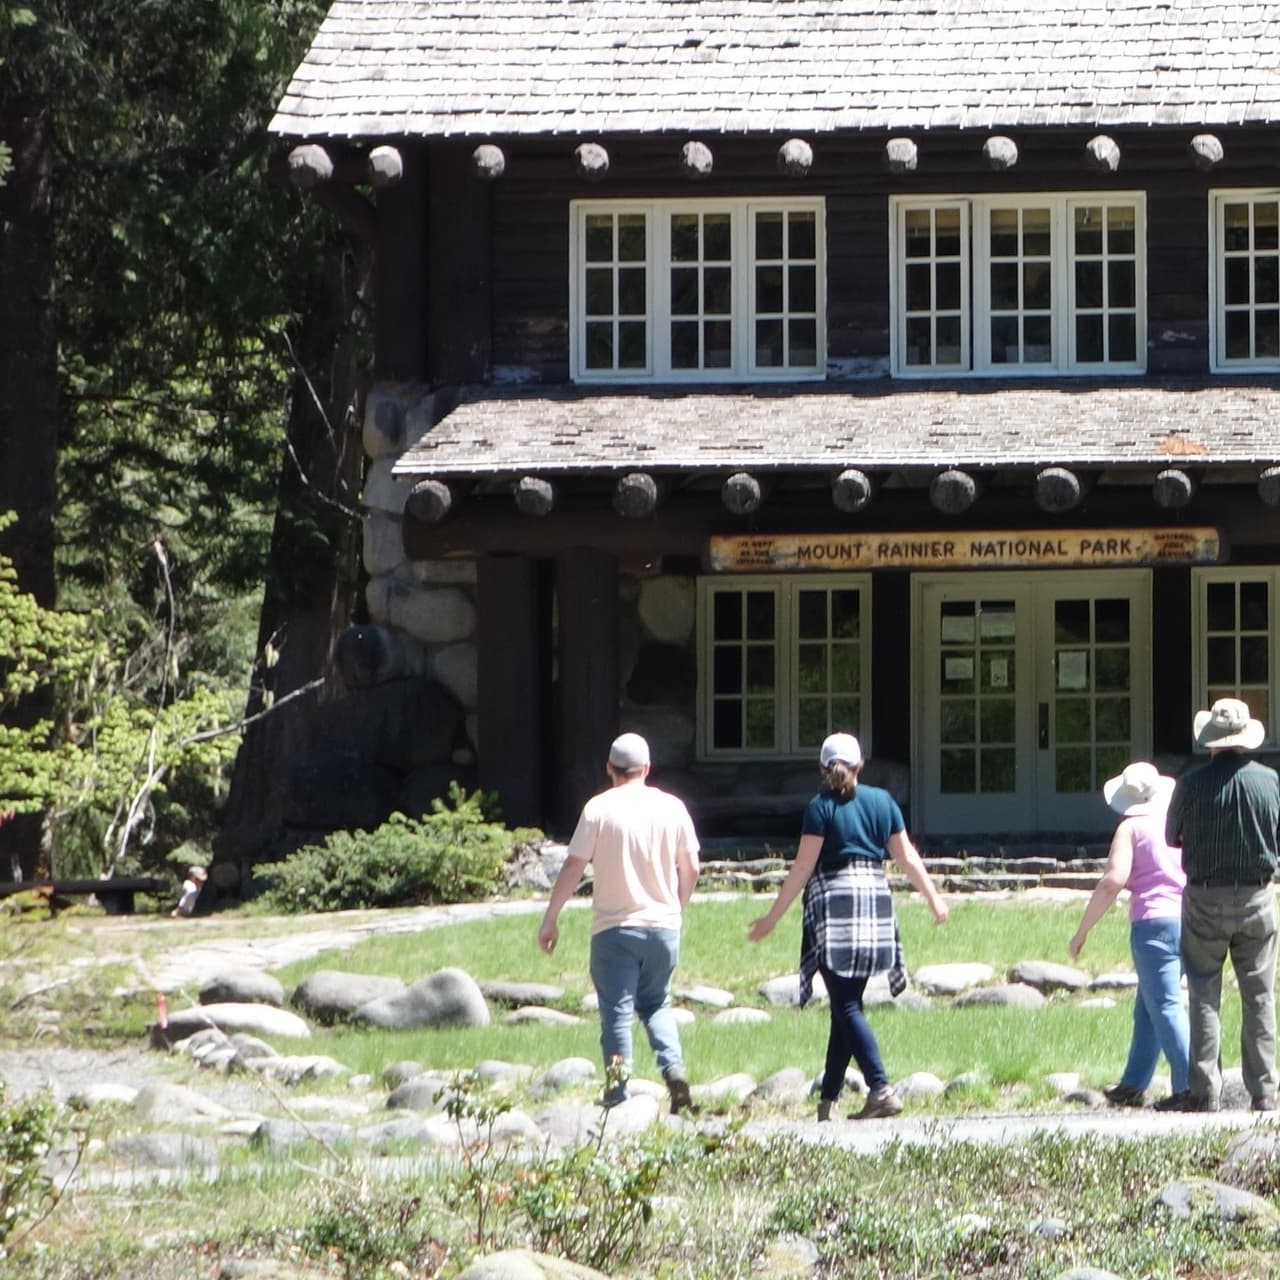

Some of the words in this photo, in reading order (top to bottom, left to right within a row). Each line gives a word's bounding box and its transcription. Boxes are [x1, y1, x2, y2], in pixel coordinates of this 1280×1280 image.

[797, 542, 863, 560] MOUNT
[877, 541, 955, 559] RAINIER
[970, 539, 1068, 557] NATIONAL
[1080, 537, 1132, 555] PARK
